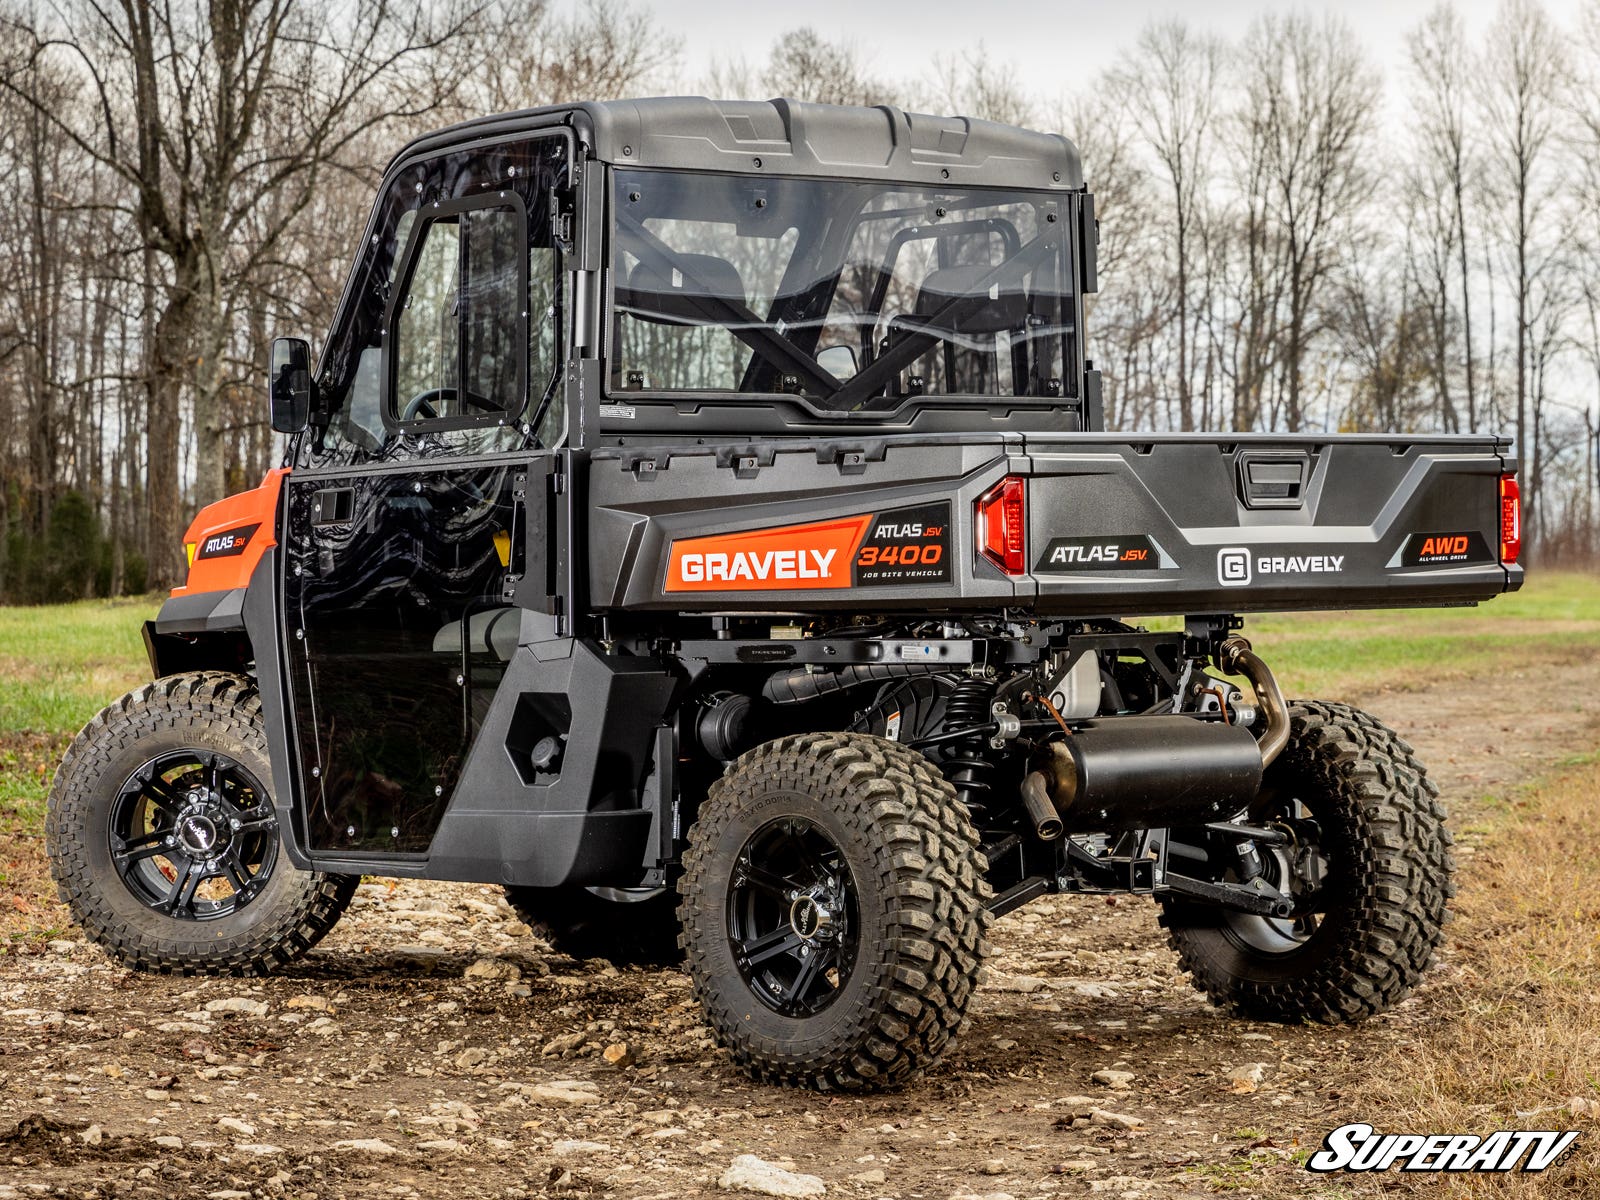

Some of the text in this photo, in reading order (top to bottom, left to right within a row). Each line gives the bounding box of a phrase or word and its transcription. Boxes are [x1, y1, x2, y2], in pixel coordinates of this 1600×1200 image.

[874, 523, 943, 539] ATLAS JSV
[206, 536, 245, 552] ATLAS JSV
[1421, 537, 1469, 555] AWD
[858, 545, 943, 566] 3400
[1049, 545, 1148, 563] ATLAS JSV
[681, 548, 837, 582] GRAVELY
[1224, 556, 1245, 579] G
[1257, 555, 1345, 574] GRAVELY
